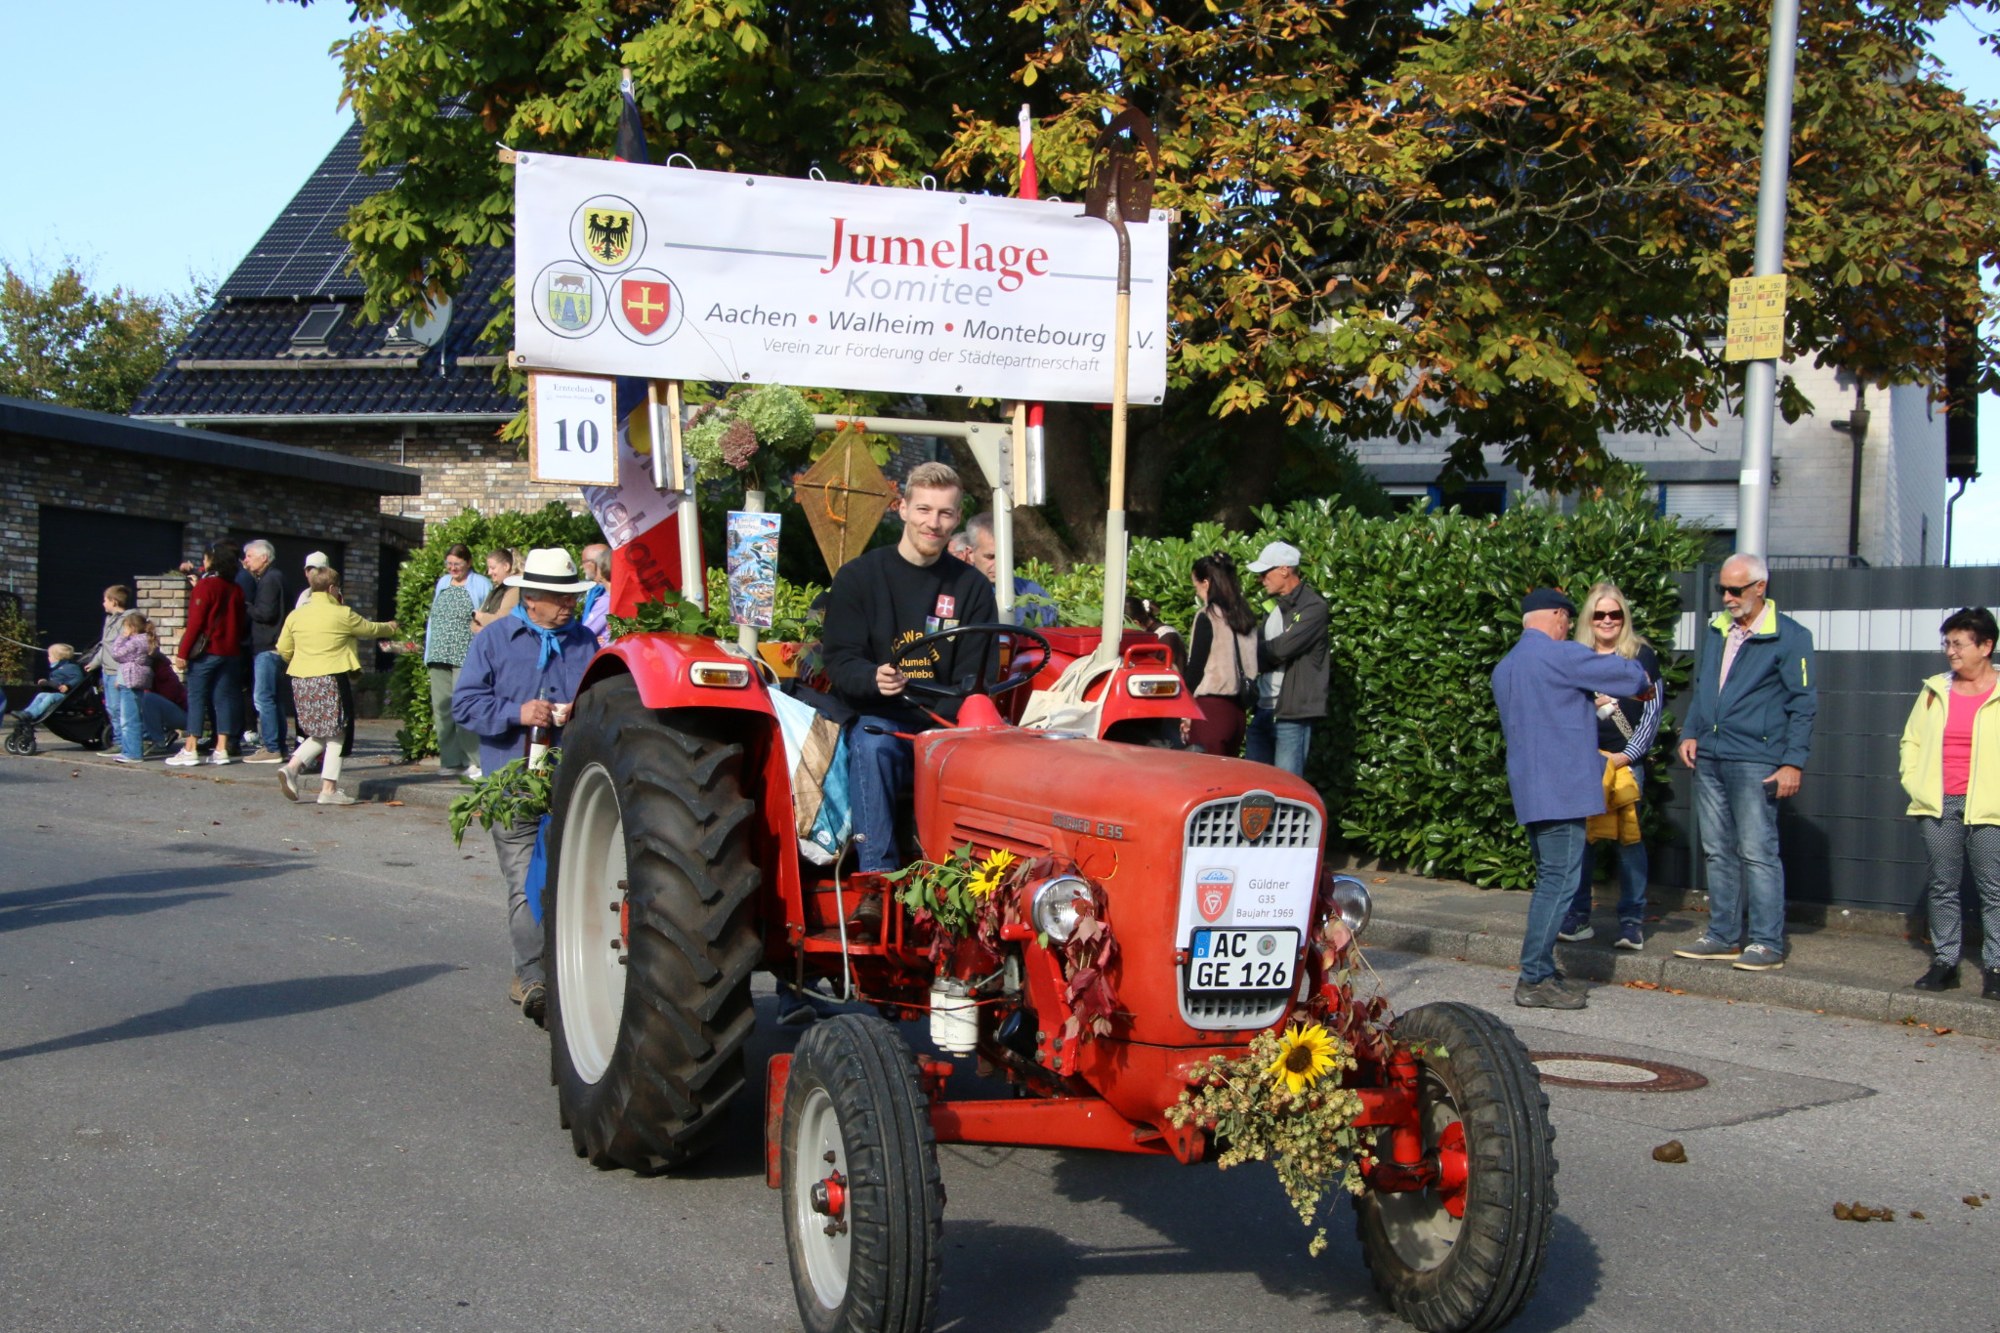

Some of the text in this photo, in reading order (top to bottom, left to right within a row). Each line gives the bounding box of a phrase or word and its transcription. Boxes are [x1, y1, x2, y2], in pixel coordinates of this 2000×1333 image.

[820, 216, 1049, 292] Jumelage
[844, 269, 994, 307] Komitee
[705, 302, 797, 328] Aachen
[829, 310, 935, 337] Walheim
[963, 318, 1107, 353] Montebourg
[763, 337, 1100, 373] Verein zur Förderung der Städtepartnerschaft
[553, 383, 595, 394] Erntedank
[553, 418, 599, 453] 10
[1249, 878, 1290, 890] Güldner
[1258, 894, 1276, 904] G35
[1236, 908, 1294, 919] Baujahr 1969
[1197, 933, 1247, 958] D AC
[1196, 961, 1286, 987] GE 126
